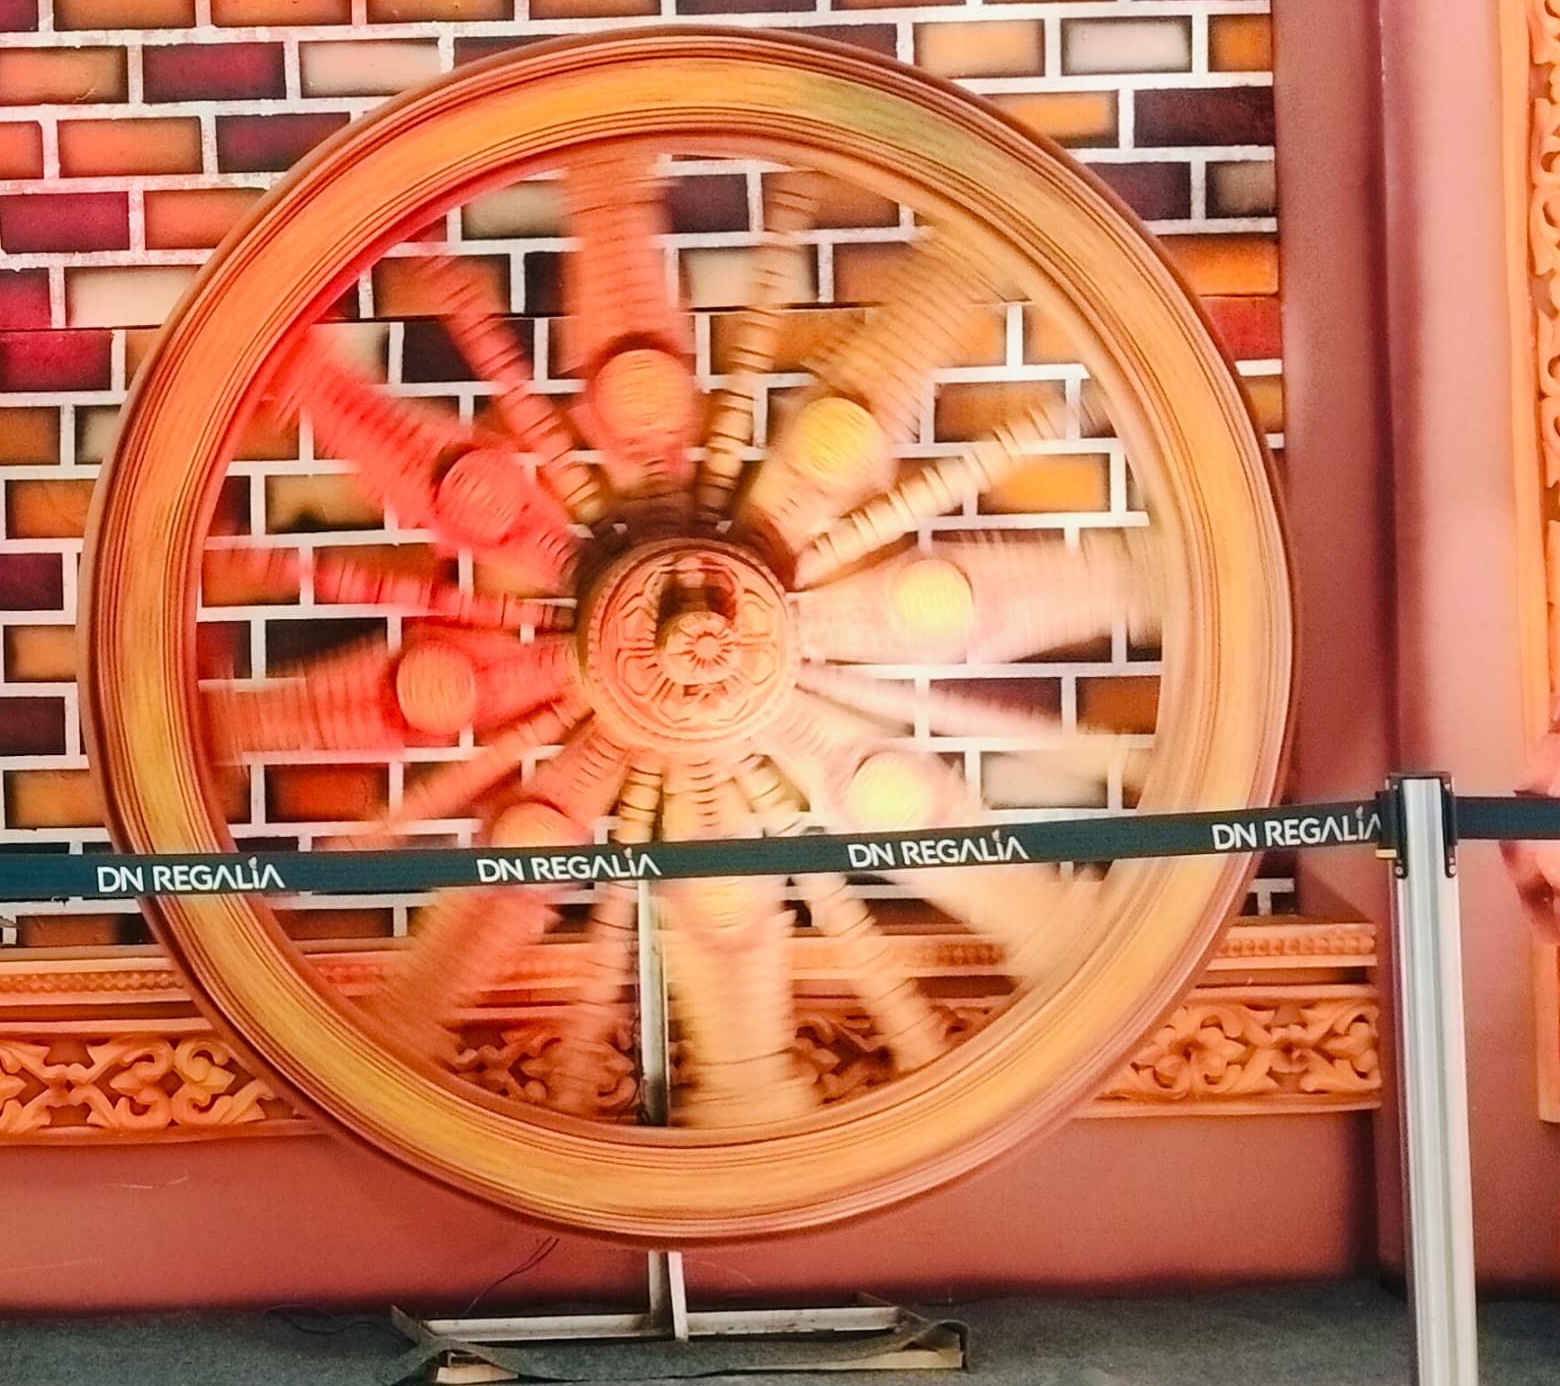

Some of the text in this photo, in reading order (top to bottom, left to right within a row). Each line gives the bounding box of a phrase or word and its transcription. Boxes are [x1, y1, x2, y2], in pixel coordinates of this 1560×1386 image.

[1211, 823, 1257, 850] DN
[847, 842, 896, 868] DN
[97, 866, 145, 893] DN
[476, 858, 525, 883] DN
